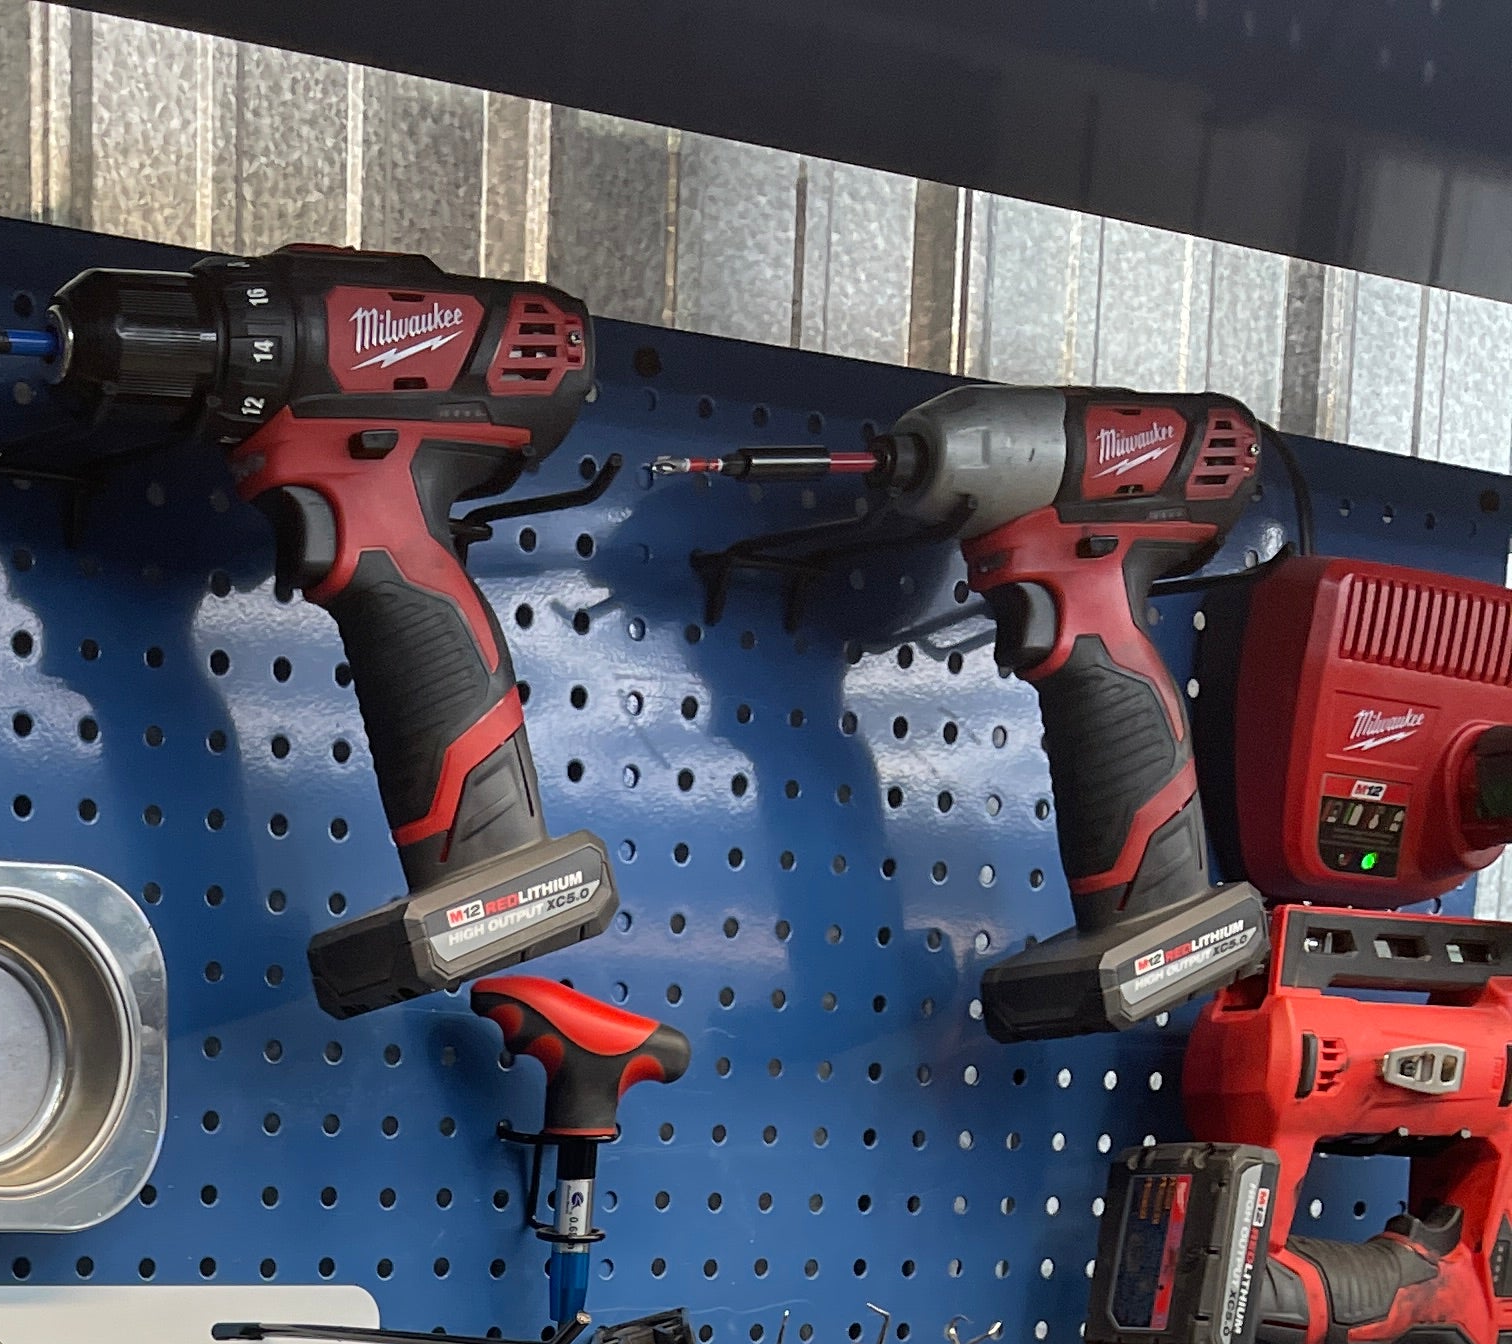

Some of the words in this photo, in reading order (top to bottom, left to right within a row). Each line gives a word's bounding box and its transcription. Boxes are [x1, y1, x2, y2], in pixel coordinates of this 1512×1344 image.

[246, 287, 269, 306] 16
[348, 302, 464, 354] Milwaukee
[253, 339, 274, 362] 14
[241, 396, 265, 415] 12
[1094, 421, 1175, 465] Milwaukee
[1349, 708, 1425, 740] Milwaukee
[1355, 783, 1384, 798] M12
[448, 922, 485, 946] HIGH
[488, 902, 545, 931] OUTPUT
[546, 887, 590, 912] XC5.0
[449, 904, 481, 924] M12
[1134, 969, 1164, 992] HIGH
[1166, 949, 1212, 977] OUTPUT
[1137, 952, 1162, 971] M12
[1254, 1190, 1268, 1225] M12
